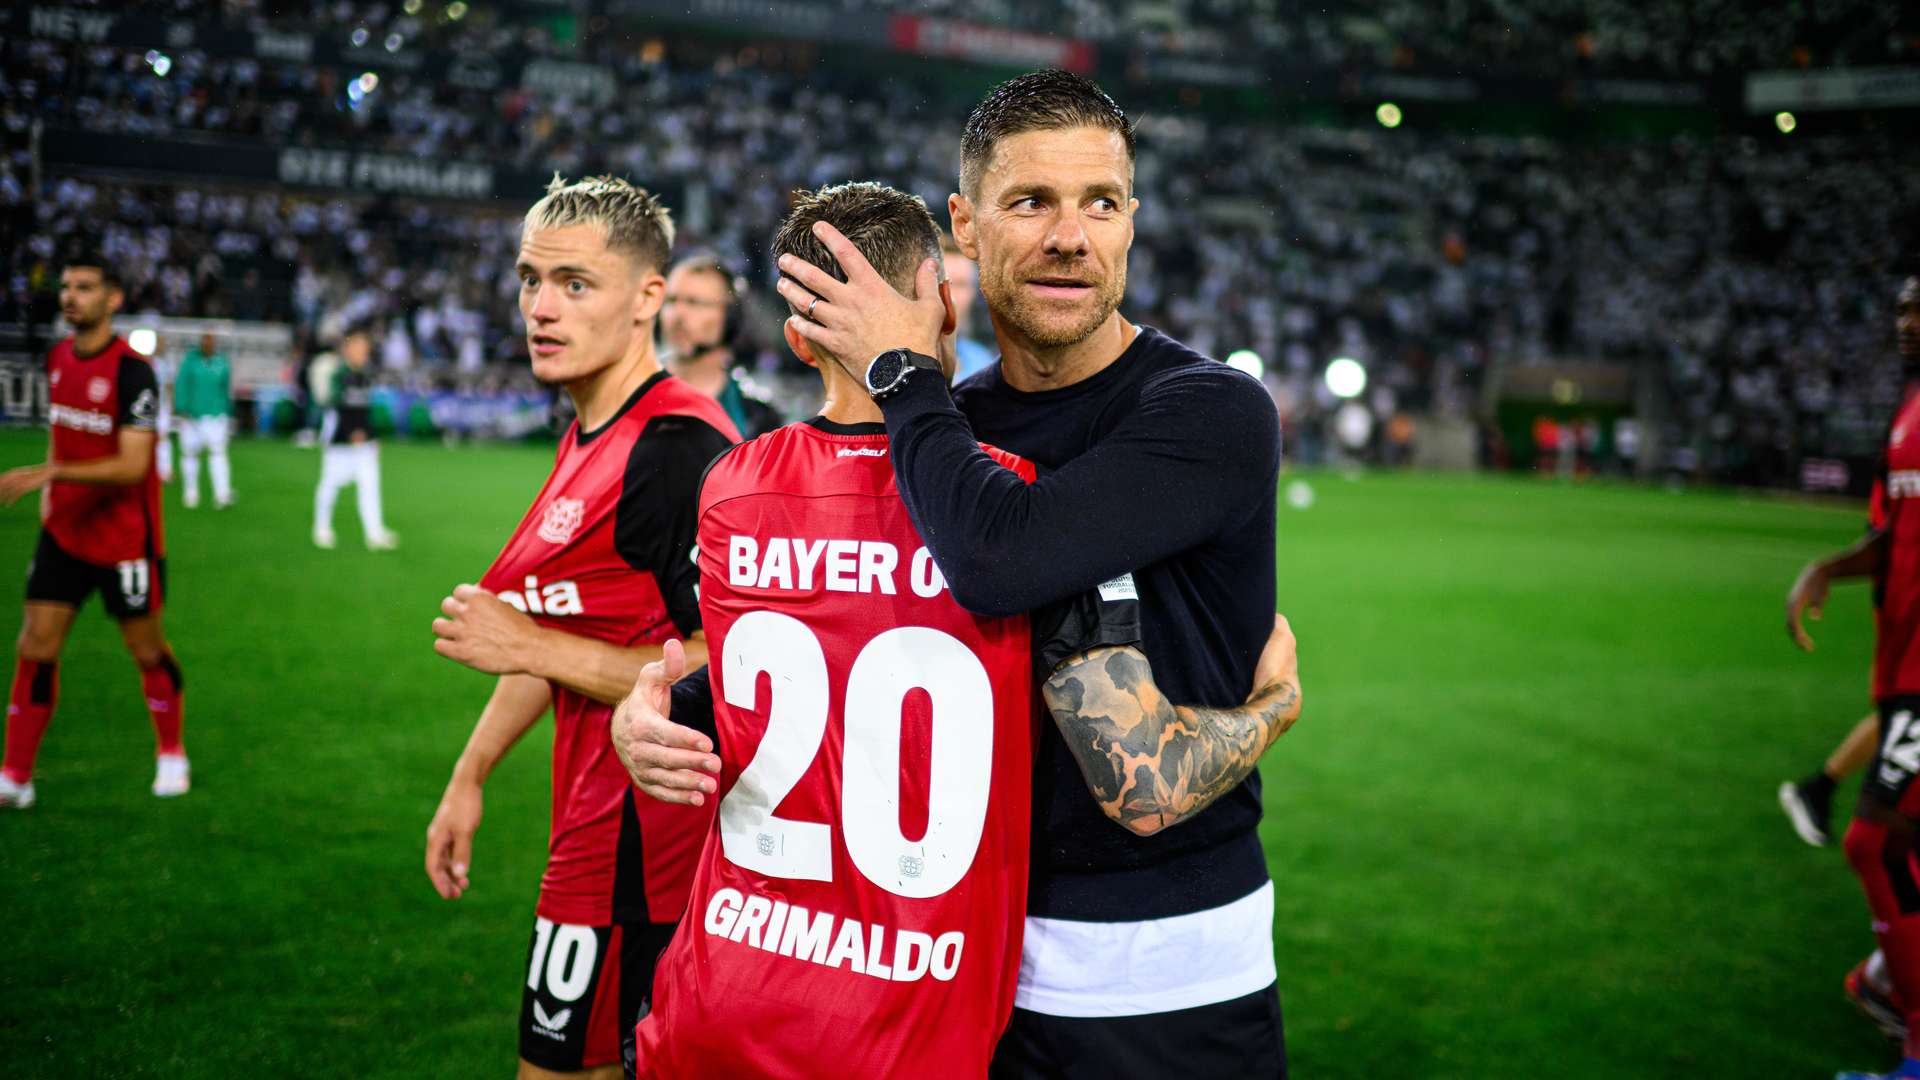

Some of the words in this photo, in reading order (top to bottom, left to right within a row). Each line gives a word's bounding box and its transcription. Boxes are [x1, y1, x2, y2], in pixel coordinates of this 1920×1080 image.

[117, 558, 149, 596] 11
[729, 535, 898, 595] BAYER
[910, 546, 951, 599] 0
[719, 610, 994, 899] 20
[1882, 709, 1920, 775] 12
[527, 916, 599, 1002] 10
[704, 887, 966, 982] GRIMALDO
